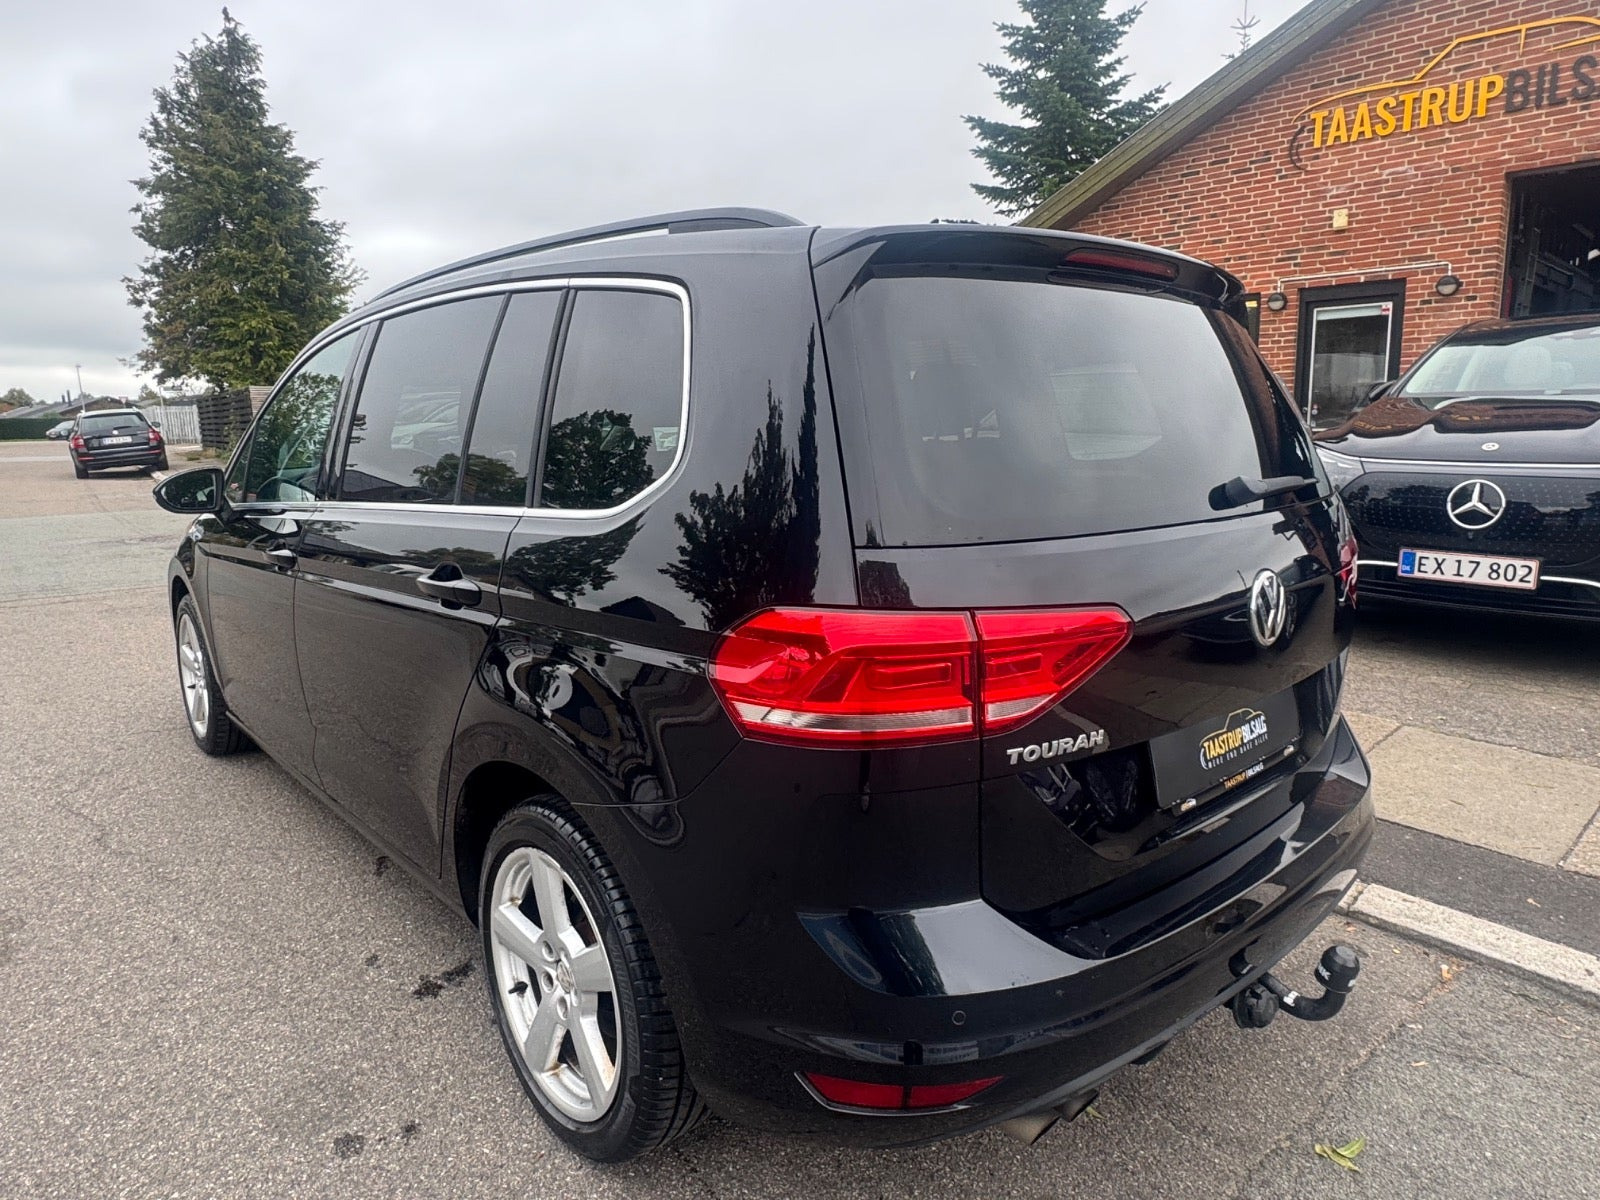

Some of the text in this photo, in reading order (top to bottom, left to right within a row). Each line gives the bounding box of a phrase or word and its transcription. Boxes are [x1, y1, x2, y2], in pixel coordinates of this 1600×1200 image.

[1417, 556, 1533, 584] EX 17 802
[1006, 729, 1104, 765] TOURAN
